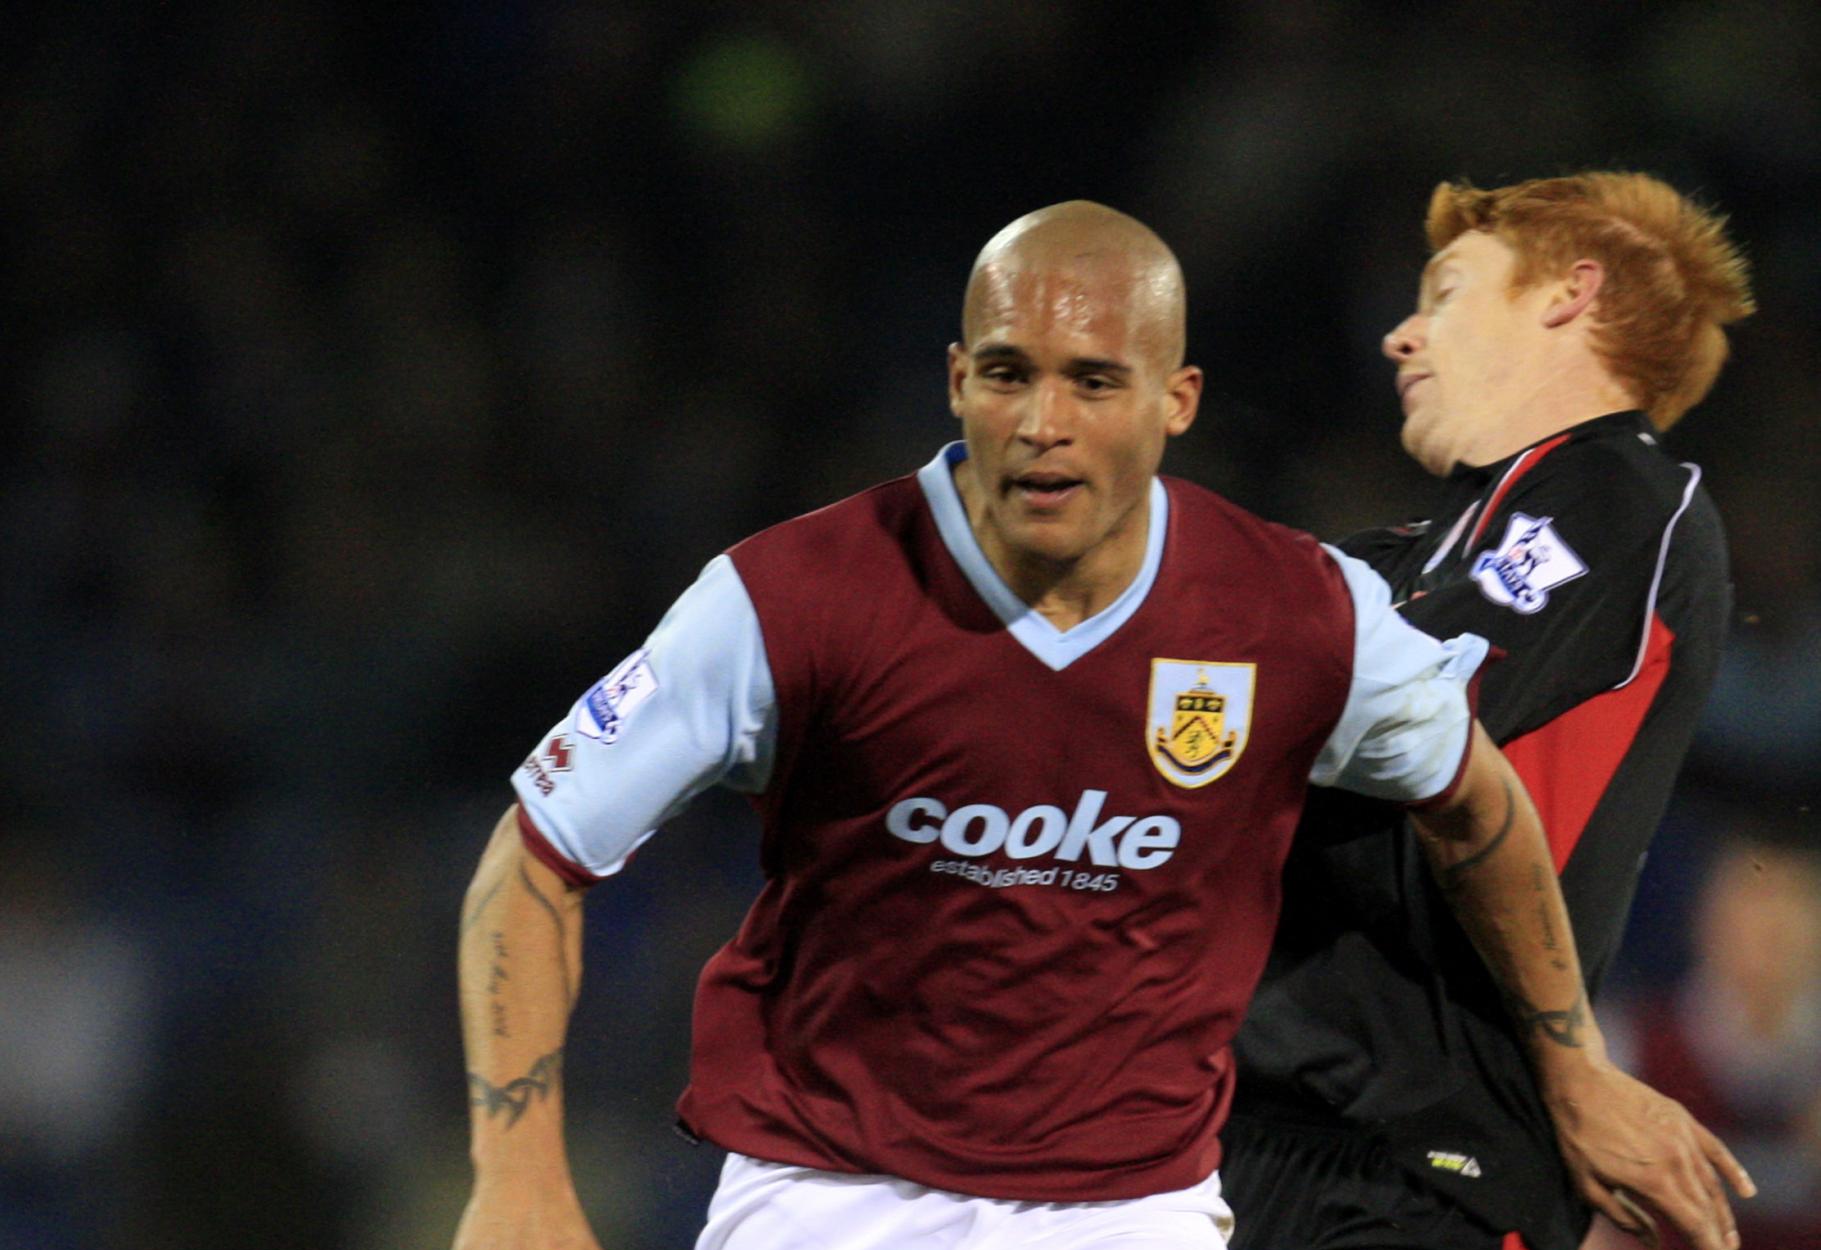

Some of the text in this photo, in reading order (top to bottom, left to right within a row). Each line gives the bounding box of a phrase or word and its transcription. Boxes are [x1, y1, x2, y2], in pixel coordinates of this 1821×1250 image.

[886, 789, 1181, 870] cooke
[930, 859, 1119, 892] established 1845
